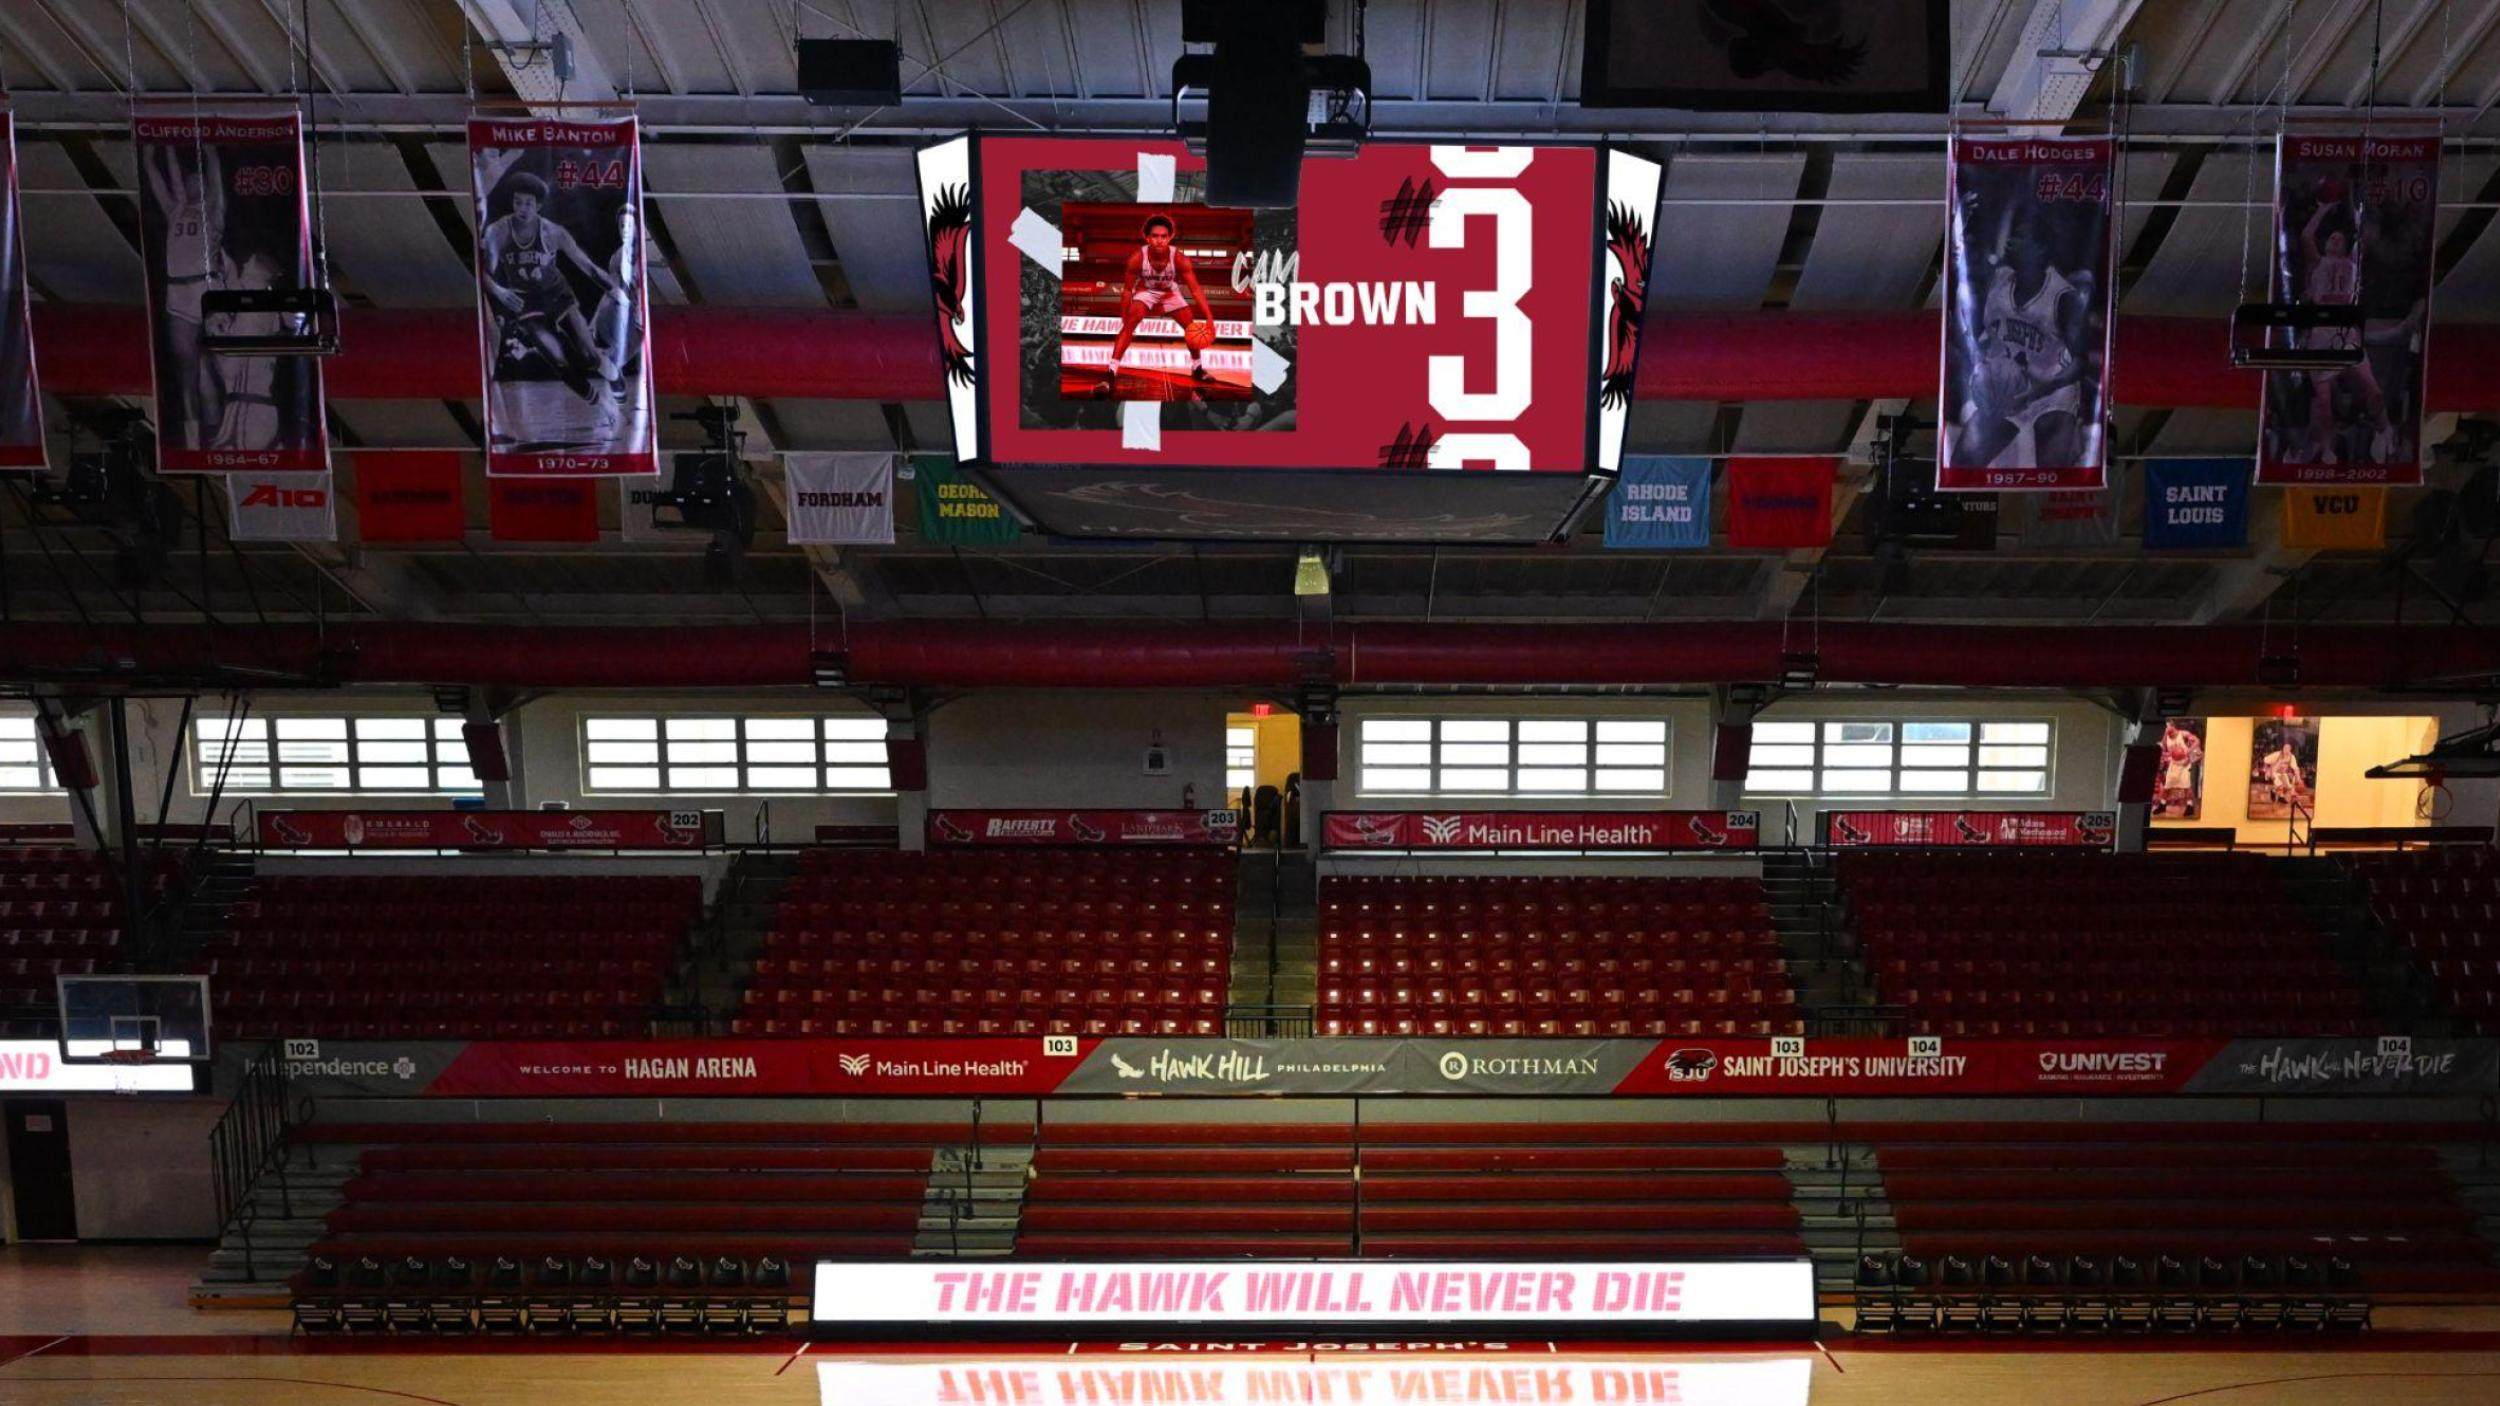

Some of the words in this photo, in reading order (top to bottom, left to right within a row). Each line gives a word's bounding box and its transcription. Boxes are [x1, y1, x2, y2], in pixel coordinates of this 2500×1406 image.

[215, 123, 295, 138] ANDERSON
[492, 126, 537, 142] MIKE
[542, 127, 617, 143] BANTOM
[1972, 146, 2018, 160] DALE
[2024, 146, 2097, 160] HODGES
[2299, 143, 2357, 158] SUSAN
[234, 165, 295, 196] #30
[555, 160, 626, 190] #44
[2036, 173, 2106, 203] #44
[174, 223, 199, 237] 30
[1231, 248, 1301, 294] CAM
[1255, 281, 1437, 326] BROWN
[797, 491, 883, 508] FORDHAM
[1626, 484, 1689, 501] RHODE
[2165, 485, 2228, 503] SAINT
[939, 503, 1001, 518] MASON
[2313, 496, 2359, 513] VCU
[1621, 505, 1693, 522] ISLAND
[2167, 507, 2225, 525] LOUIS
[672, 814, 699, 827] 202
[1209, 812, 1235, 825] 203
[1729, 814, 1754, 827] 204
[2087, 815, 2112, 828] 205
[986, 818, 1057, 837] RAFFERTY
[1468, 825, 1522, 844] Main
[1527, 825, 1574, 844] Line
[289, 1043, 315, 1056] 102
[1048, 1041, 1073, 1053] 103
[1775, 1042, 1800, 1054] 103
[1911, 1041, 1937, 1053] 104
[2382, 1040, 2408, 1052] 104
[519, 1066, 593, 1075] WELCOME
[600, 1066, 618, 1075] TO
[625, 1057, 690, 1079] HAGAN
[695, 1056, 758, 1079] ARENA
[877, 1061, 920, 1077] Main
[924, 1061, 961, 1077] Line
[1150, 1048, 1216, 1083] HAWK
[1218, 1049, 1271, 1083] HILL
[1277, 1064, 1387, 1073] PHILADELPHIA
[1472, 1057, 1599, 1075] ROTHMAN
[1723, 1056, 1774, 1078] SAINT
[1777, 1056, 1861, 1078] JOSEPH'S
[1865, 1056, 1967, 1078] UNIVERSITY
[2059, 1053, 2168, 1071] UNIVEST
[2260, 1046, 2330, 1084] HAWK
[2343, 1050, 2414, 1080] NEVER
[2415, 1053, 2456, 1077] DIE
[1669, 1067, 1711, 1081] SJU
[933, 1272, 1042, 1312] THE
[1055, 1272, 1230, 1312] HAWK
[1244, 1272, 1372, 1312] WILL
[1389, 1272, 1577, 1312] NEVER
[1592, 1272, 1686, 1312] DIE
[1117, 1342, 1267, 1351] SAINT
[1283, 1342, 1510, 1351] JOSEPH'S
